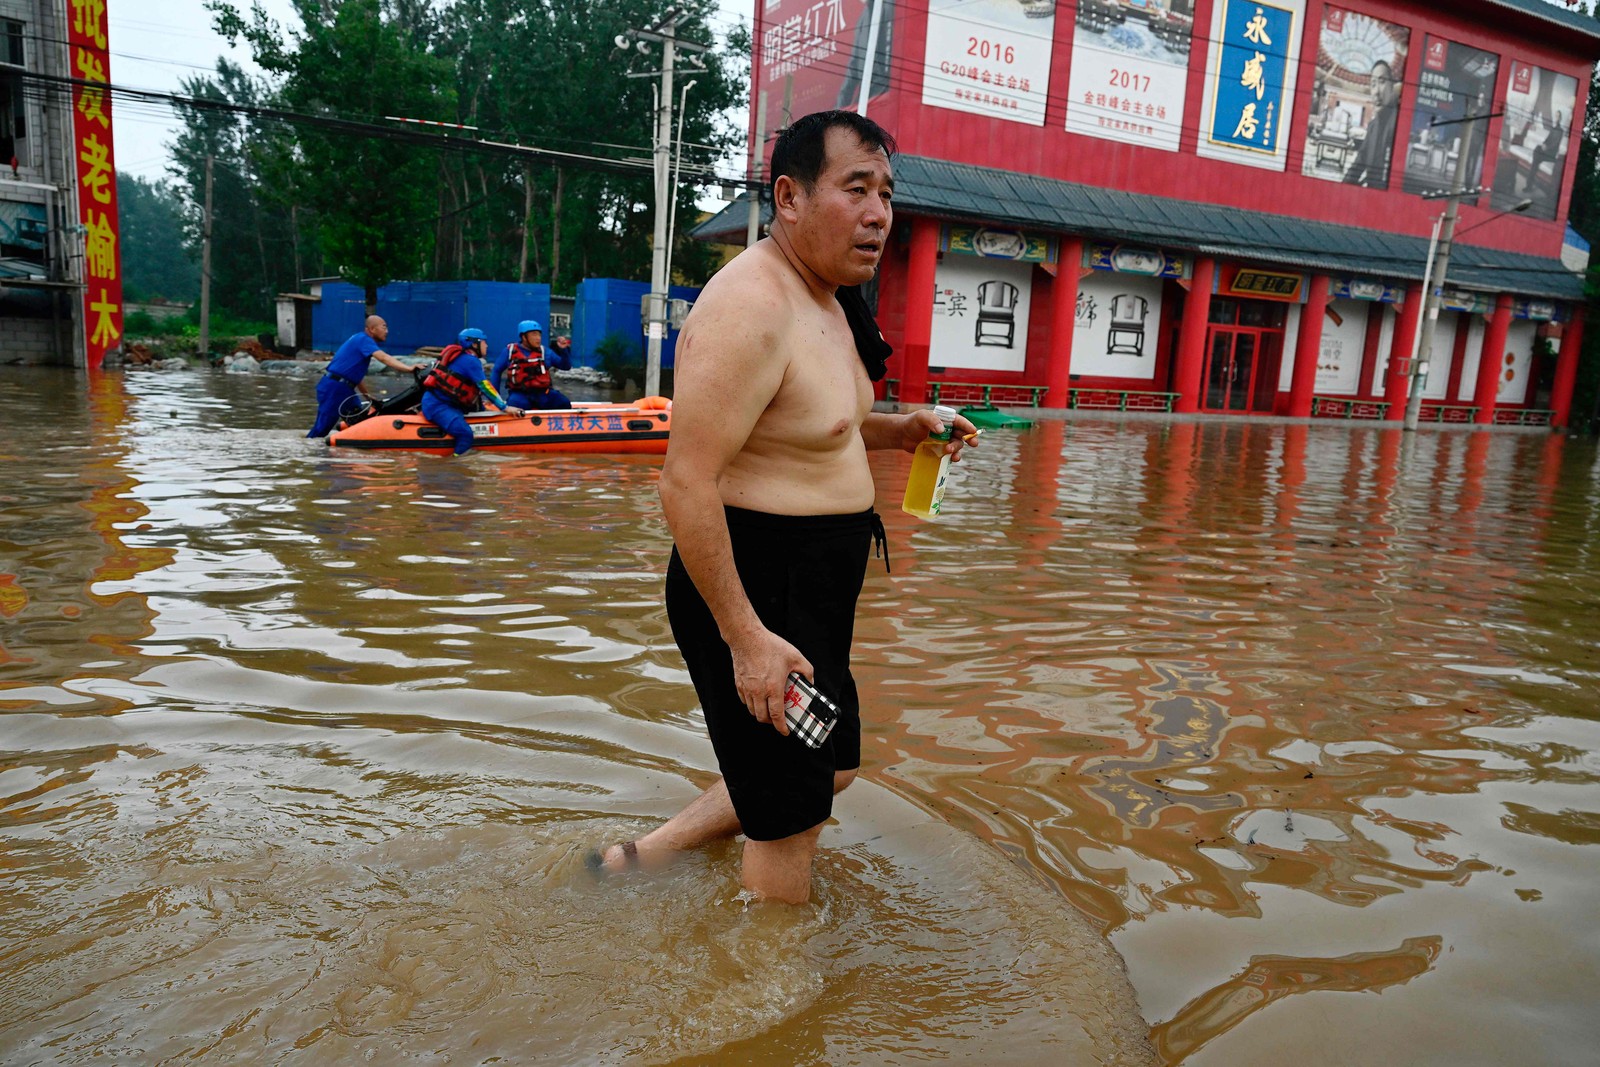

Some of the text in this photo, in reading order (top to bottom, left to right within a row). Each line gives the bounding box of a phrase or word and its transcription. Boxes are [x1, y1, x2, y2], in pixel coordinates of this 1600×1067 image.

[967, 37, 1015, 64] 2016
[940, 61, 1031, 92] G20峰会主会场
[1109, 68, 1151, 92] 2017
[1084, 91, 1166, 119] 金砖峰会主会场
[71, 0, 120, 348] 批发老榆木
